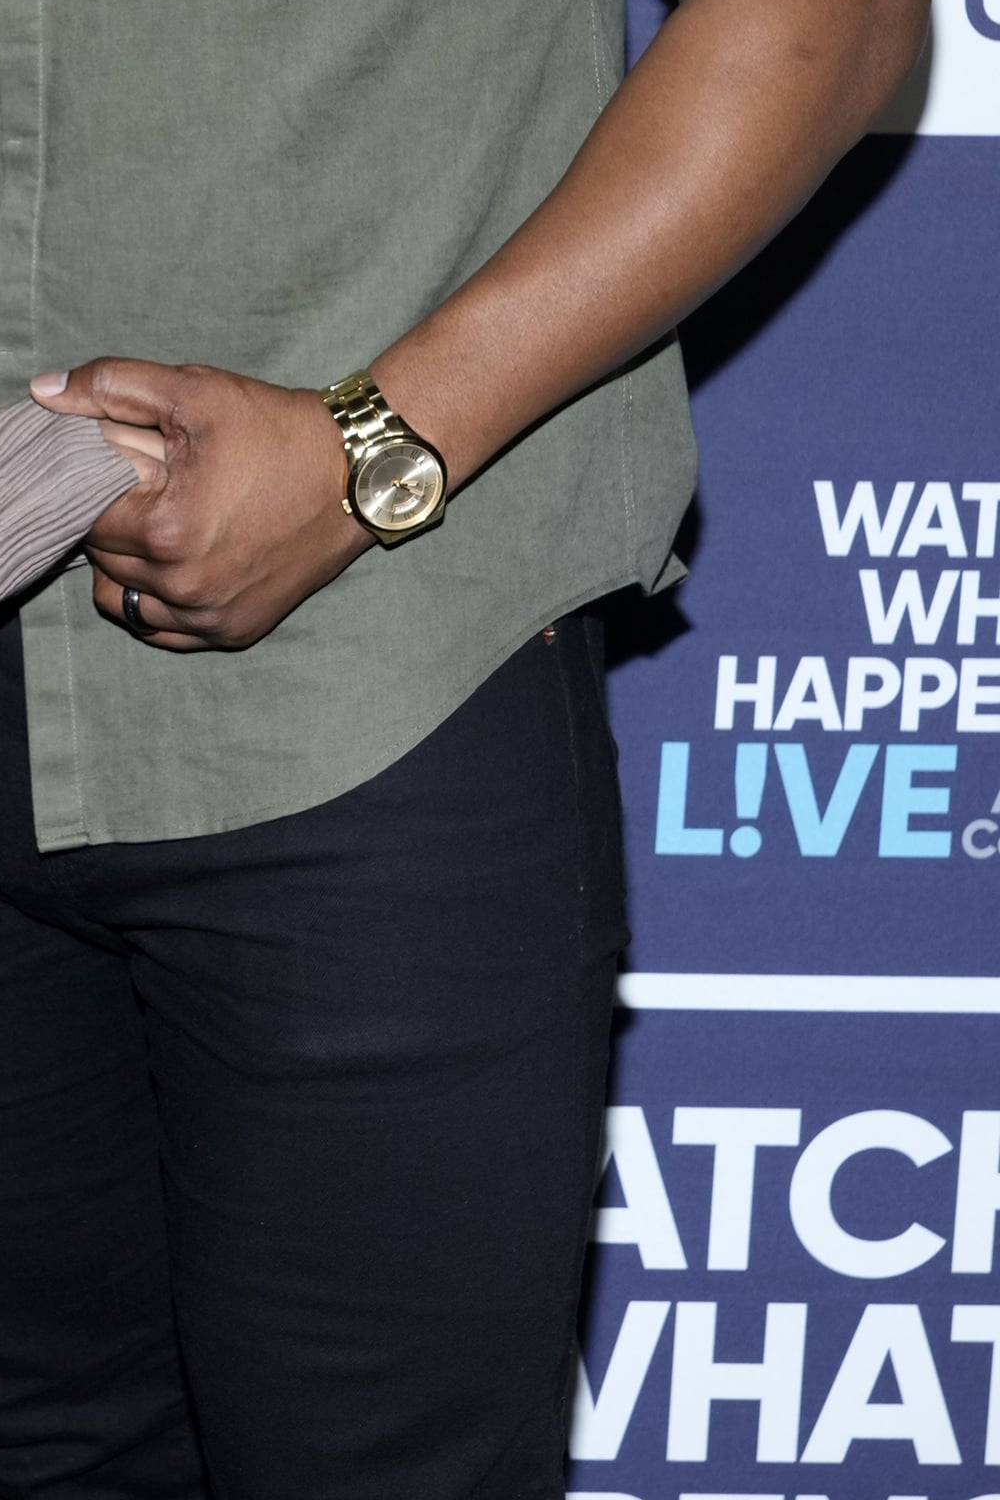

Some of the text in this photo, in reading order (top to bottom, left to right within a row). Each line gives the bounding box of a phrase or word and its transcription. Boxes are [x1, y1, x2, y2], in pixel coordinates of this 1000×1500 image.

[813, 480, 1000, 558] WAT
[859, 569, 1000, 646] WH
[714, 655, 1000, 733] HAPPE
[655, 741, 958, 858] L!VE
